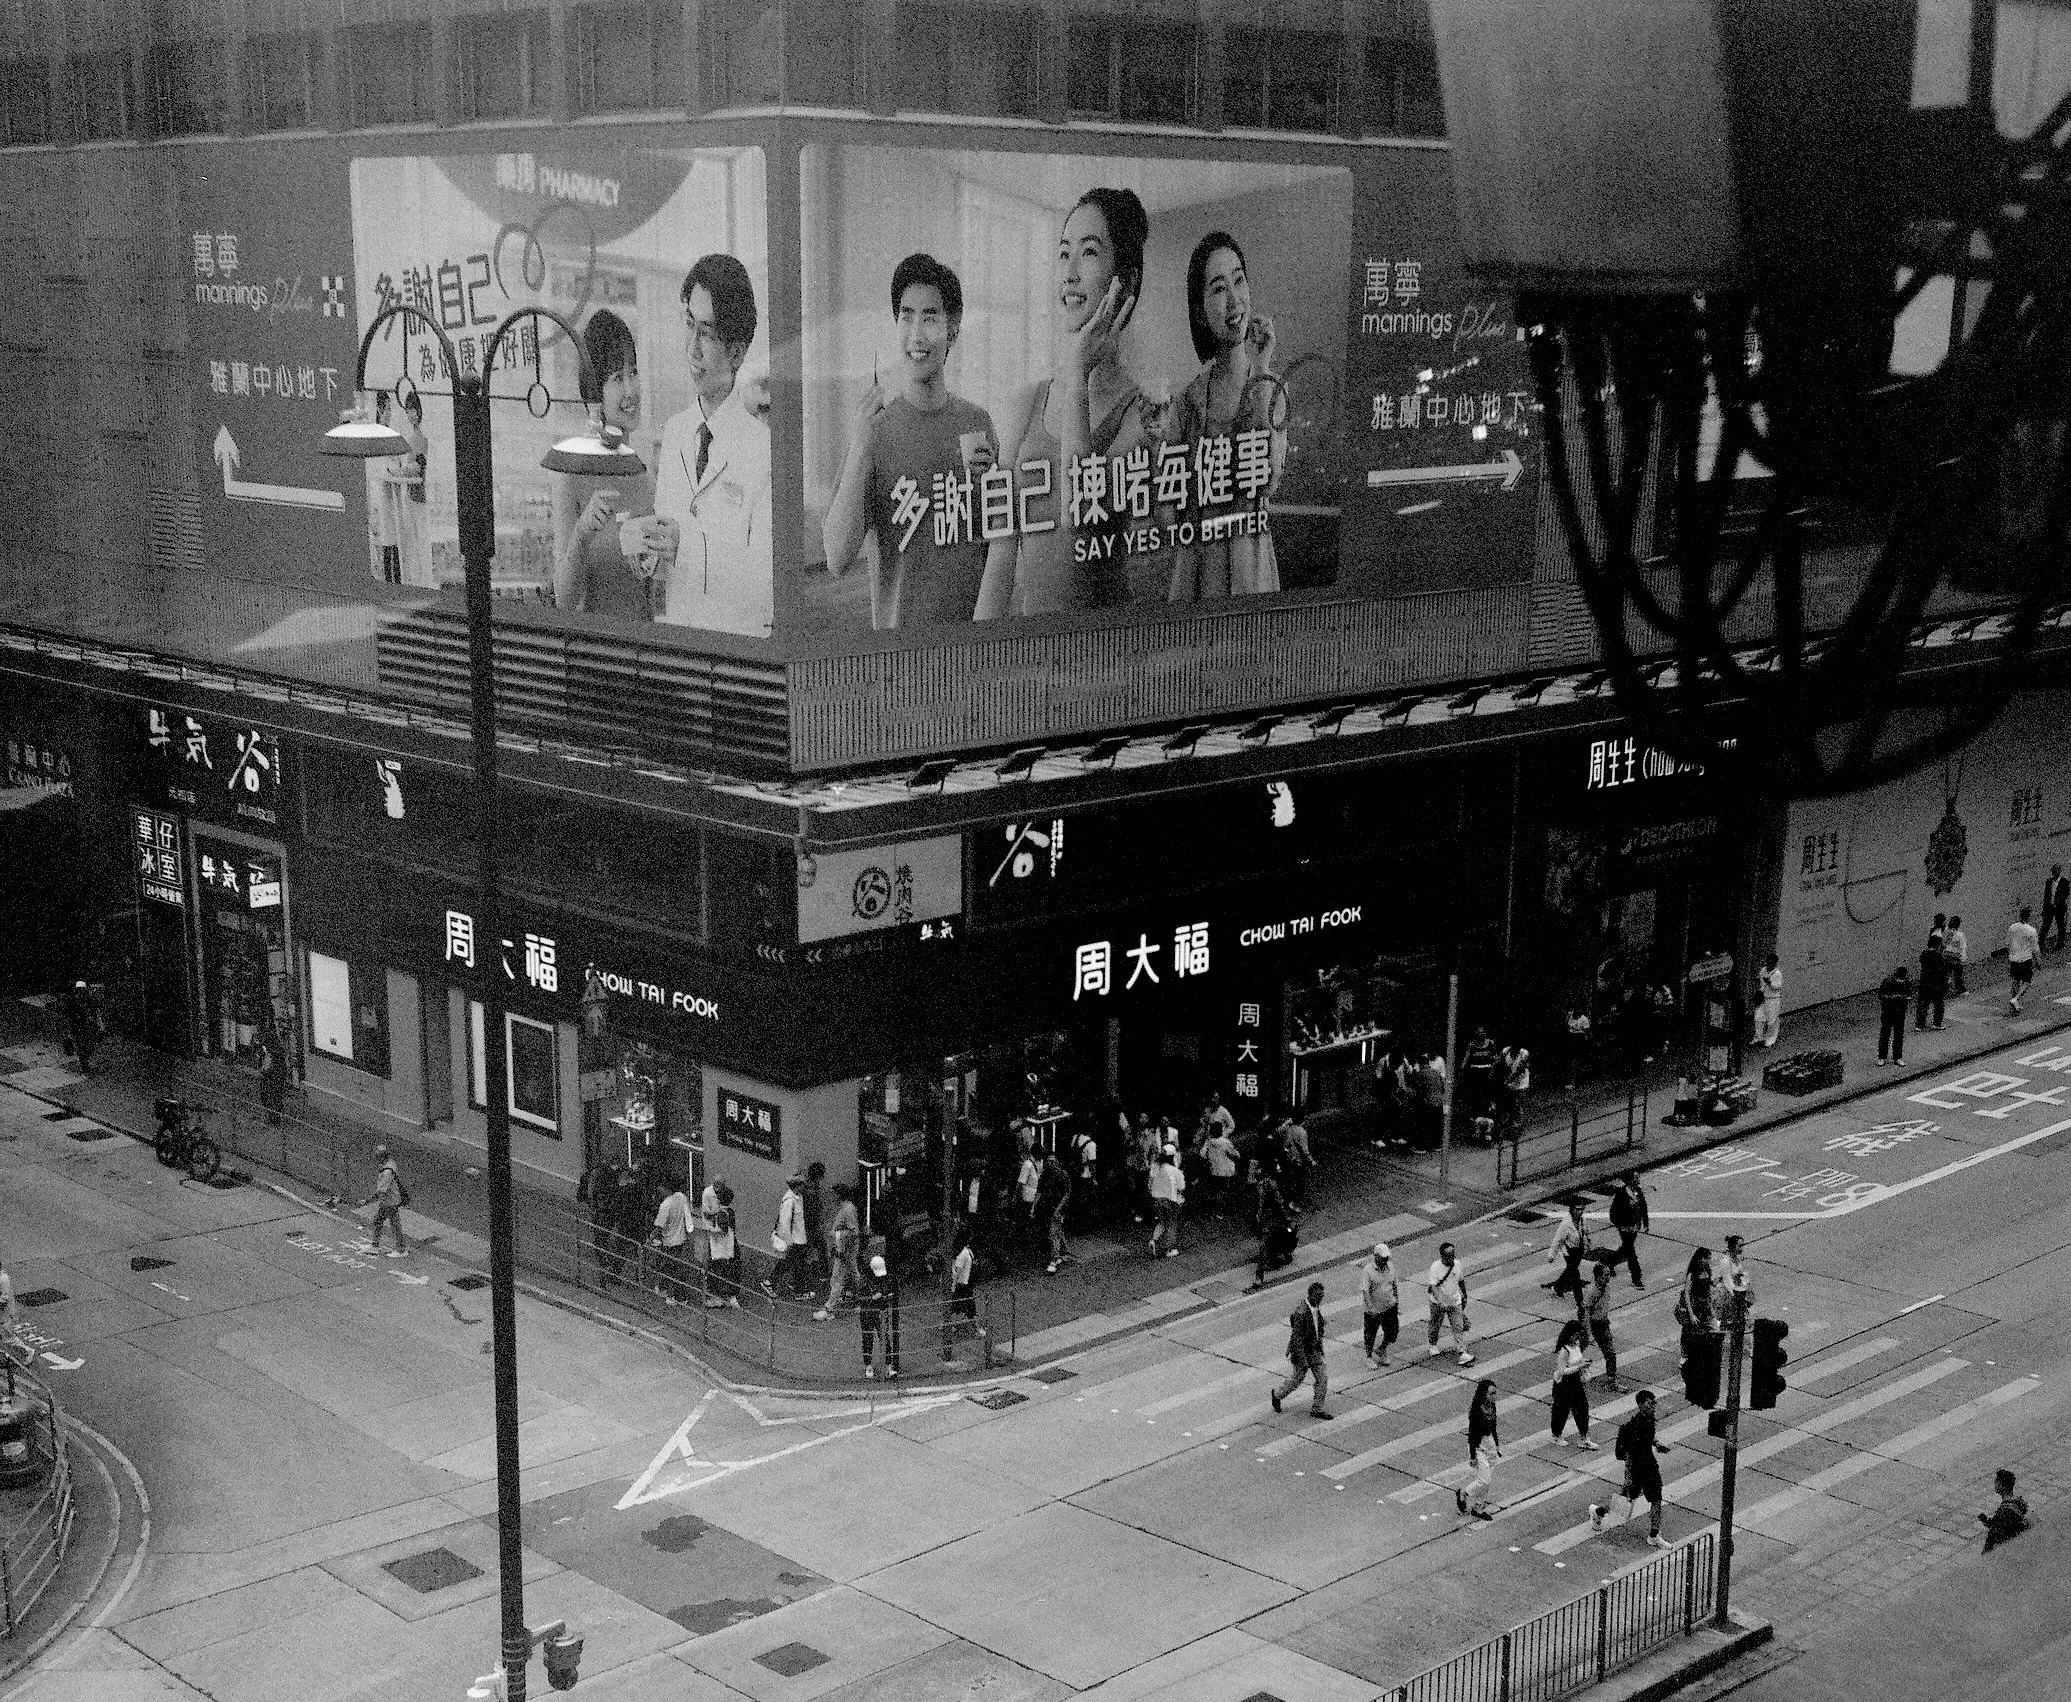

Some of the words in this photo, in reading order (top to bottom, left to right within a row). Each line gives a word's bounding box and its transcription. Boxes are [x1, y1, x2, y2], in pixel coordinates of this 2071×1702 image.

[195, 280, 268, 311] mannings
[1363, 257, 1422, 307] 萬寧
[1362, 308, 1452, 340] mannings
[890, 457, 1056, 553] 多謝自己
[1068, 428, 1272, 528] 揀啱每健事
[1074, 535, 1115, 562] SAY
[1123, 527, 1160, 554] YES
[1167, 522, 1194, 547] TO
[1201, 510, 1270, 542] BETTER
[1587, 736, 1637, 790] 周生生
[140, 847, 177, 881] 冰室
[1800, 830, 1840, 875] 周生生
[1073, 920, 1210, 1002] 周大福
[1240, 922, 1285, 947] CHOW
[1290, 915, 1314, 936] TAI
[1321, 905, 1362, 930] FOOK
[637, 980, 665, 1006] TAI
[672, 990, 719, 1021] FOOK
[1236, 1002, 1260, 1098] 周大福
[725, 1099, 772, 1132] 周大福
